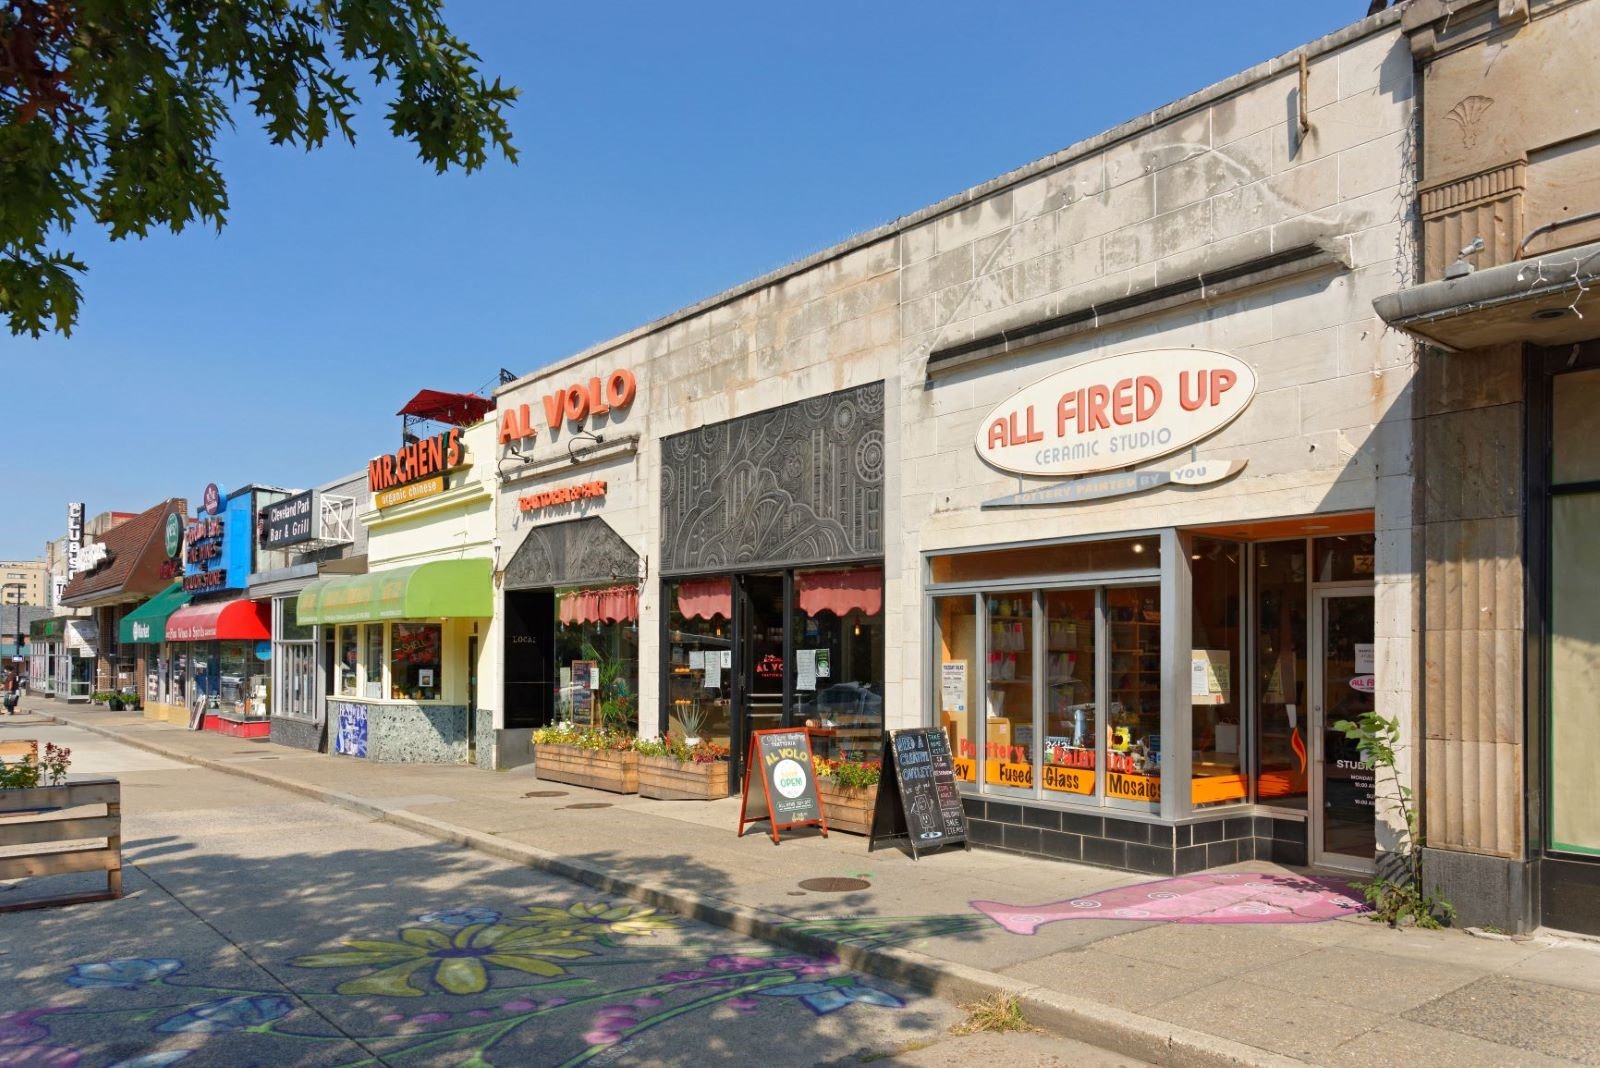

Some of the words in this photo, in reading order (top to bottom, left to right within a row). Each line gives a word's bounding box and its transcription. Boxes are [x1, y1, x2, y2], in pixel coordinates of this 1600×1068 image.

[499, 404, 537, 445] AL
[543, 368, 636, 430] VOLO
[988, 405, 1044, 449] ALL
[1057, 375, 1163, 437] FIRED
[1178, 368, 1237, 412] UP
[396, 427, 463, 483] CHEN'S
[1035, 441, 1099, 466] CERAMIC
[1110, 427, 1172, 453] STUDIO
[381, 487, 407, 505] organic
[408, 481, 437, 498] chinese
[1014, 486, 1072, 504] POTTERY
[1076, 478, 1136, 496] PAINTED
[1140, 474, 1160, 486] BY
[1175, 466, 1206, 480] YOU
[271, 502, 297, 522] Cleveland
[297, 498, 309, 515] Park
[270, 528, 282, 542] Bar
[284, 524, 289, 538] &
[292, 519, 309, 536] Grill
[765, 751, 779, 766] AL
[778, 747, 808, 763] VOLO
[955, 763, 969, 780] ay
[999, 763, 1032, 784] Fused
[1046, 767, 1079, 790] Glass
